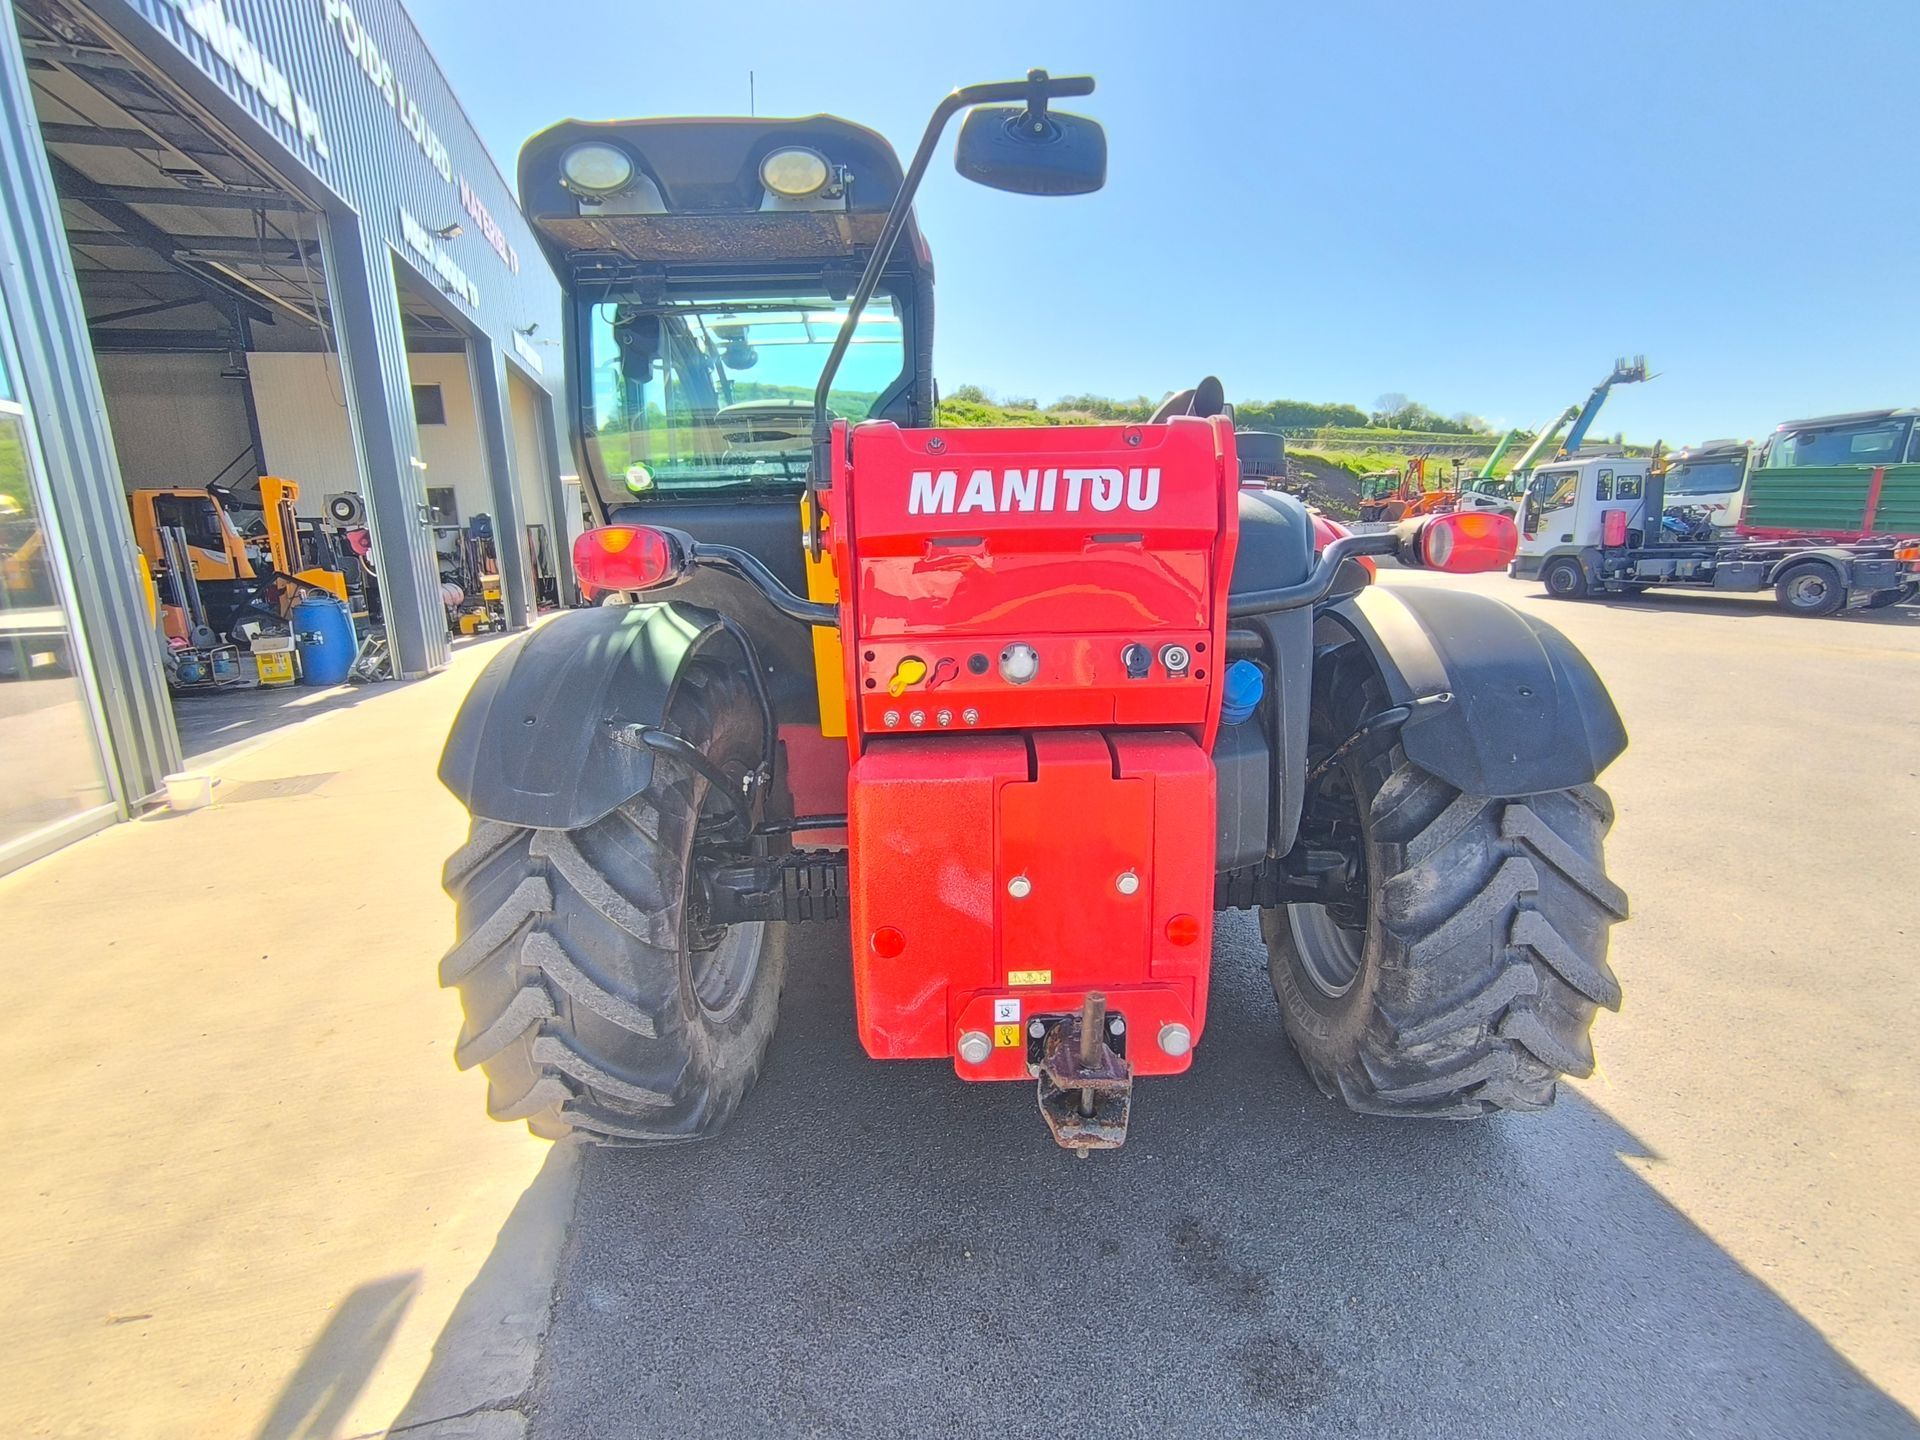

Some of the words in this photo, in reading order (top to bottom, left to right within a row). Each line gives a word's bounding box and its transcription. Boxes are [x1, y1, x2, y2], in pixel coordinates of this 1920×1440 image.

[323, 0, 395, 109] POIDS
[398, 80, 451, 183] LOURD
[908, 467, 1161, 515] MANITOU
